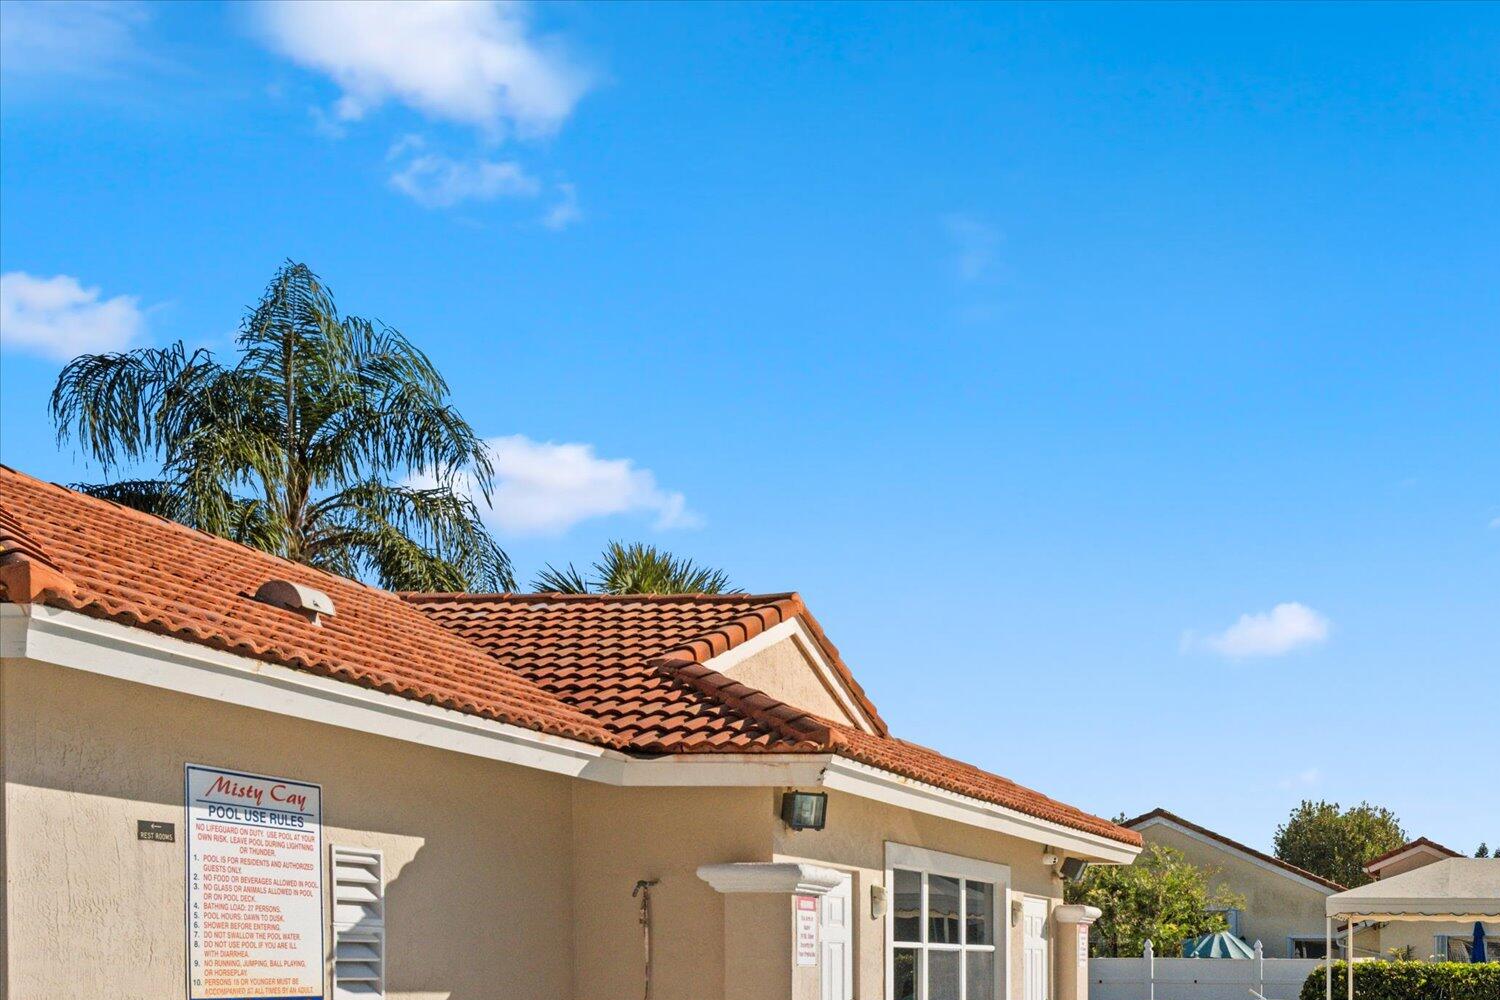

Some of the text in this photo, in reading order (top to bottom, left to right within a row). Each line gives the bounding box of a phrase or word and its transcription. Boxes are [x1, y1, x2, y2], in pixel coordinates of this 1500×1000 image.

[205, 776, 307, 811] Misty Cay
[208, 805, 304, 828] POOL USE RULES
[196, 823, 204, 831] NO
[206, 824, 238, 834] LIFEGUARD
[140, 832, 154, 840] REST
[198, 833, 212, 841] OWN
[230, 836, 248, 844] LEAVE
[249, 838, 264, 846] POOL
[264, 840, 286, 848] DURING
[286, 842, 314, 851] LIGHTNING
[204, 854, 220, 862] POOL
[240, 858, 270, 867] RESIDENTS
[282, 862, 314, 870] AUTHORIZED
[204, 864, 226, 872] GUESTS
[214, 874, 230, 882] FOOD
[240, 876, 272, 886] BEVERAGES
[273, 878, 298, 887] ALLOWED
[243, 886, 266, 894] ANIMALS
[268, 888, 292, 896] ALLOWED
[204, 902, 228, 910] BATHING
[204, 922, 229, 930] SHOWER
[230, 922, 252, 930] BEFORE
[228, 932, 254, 940] SWALLOW
